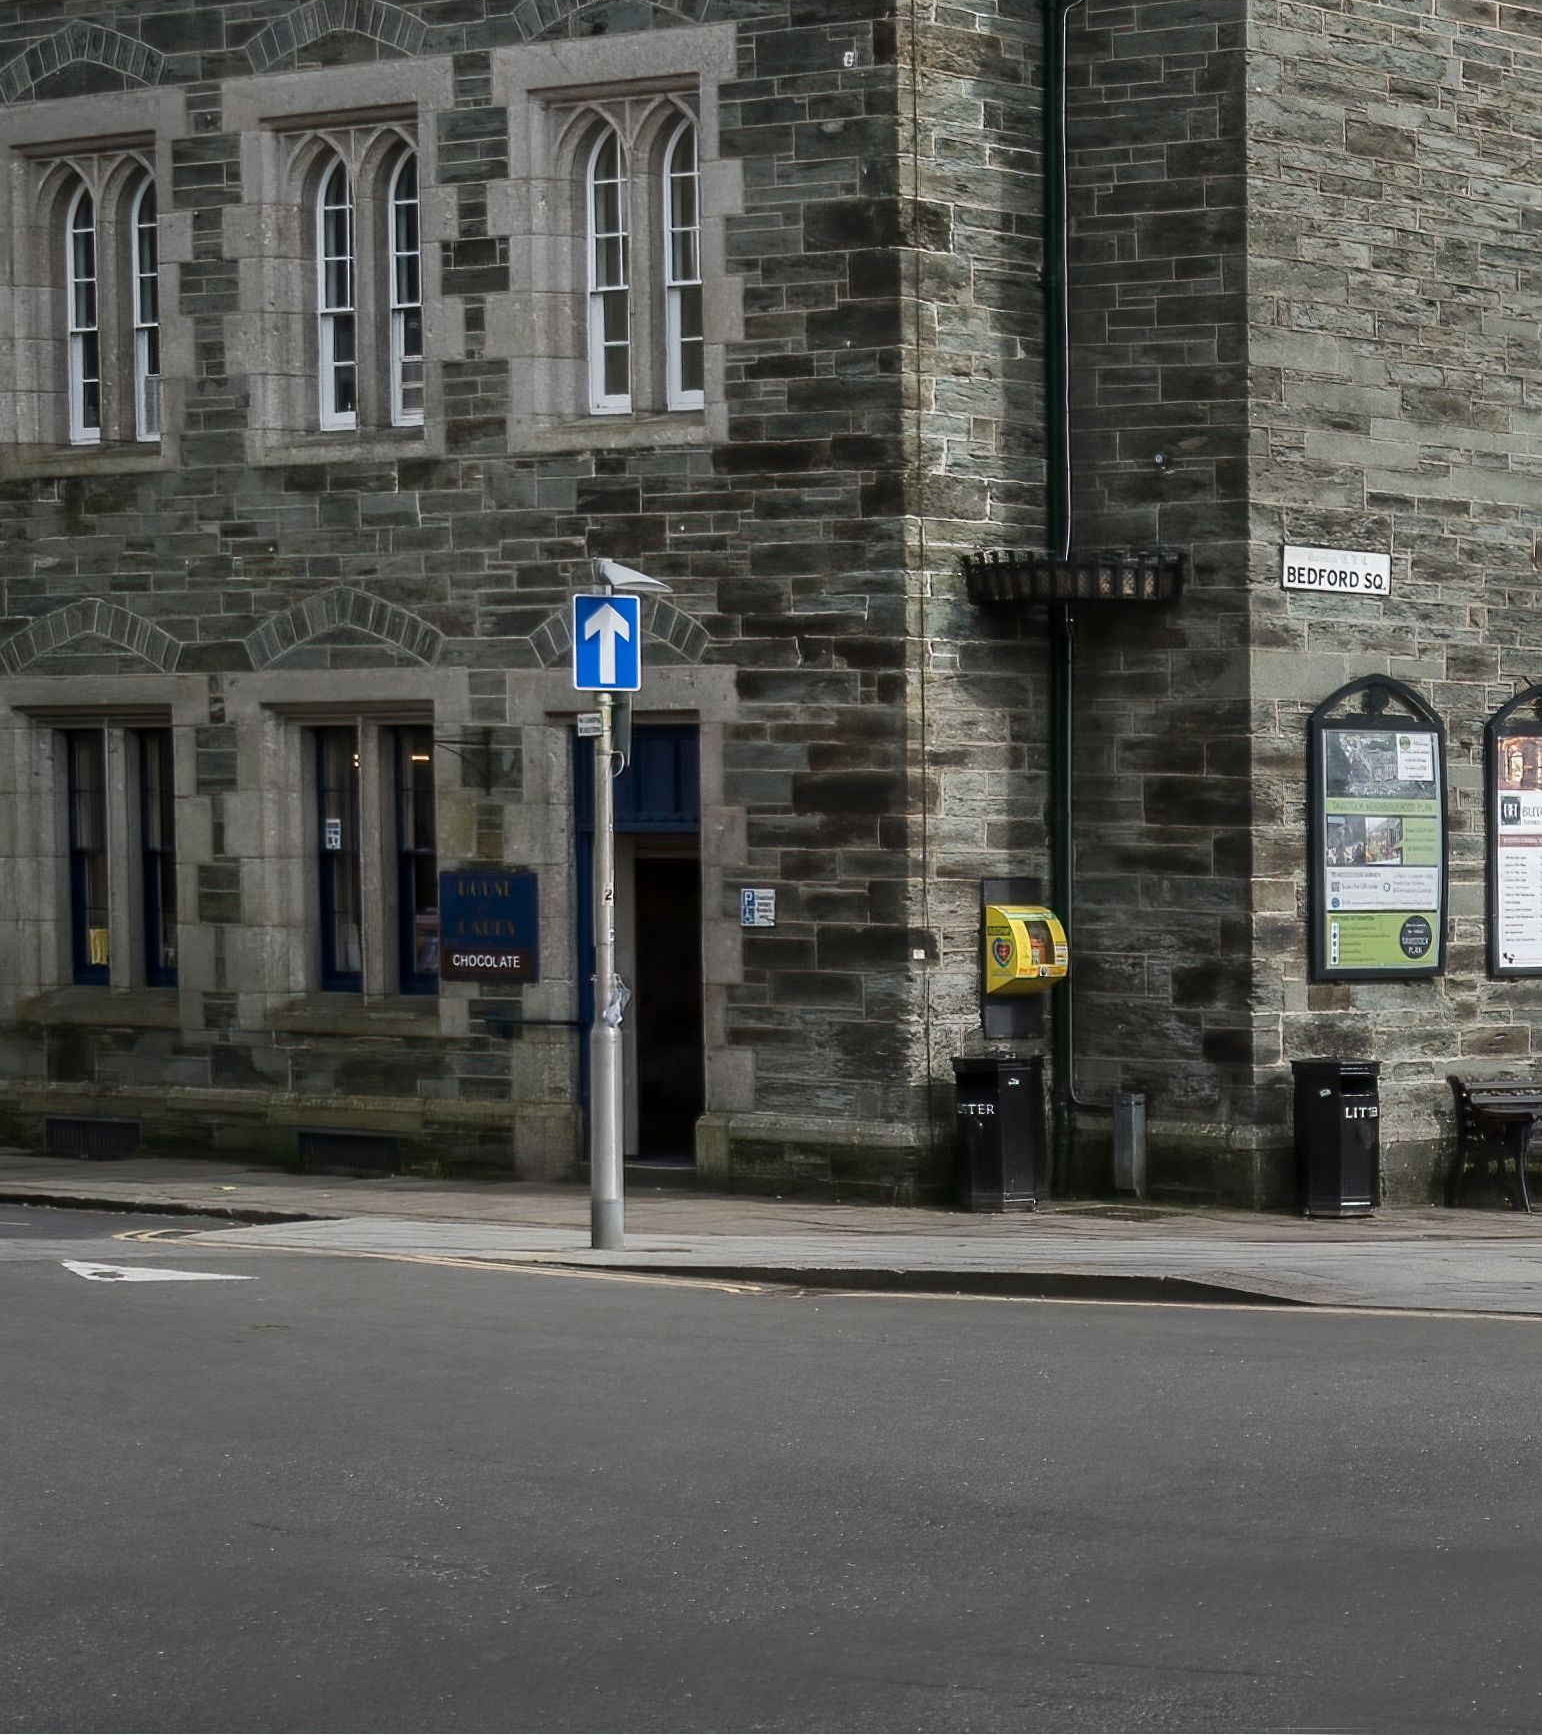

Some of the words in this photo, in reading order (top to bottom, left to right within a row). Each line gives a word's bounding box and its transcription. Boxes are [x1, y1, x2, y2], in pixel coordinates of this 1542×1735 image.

[1287, 566, 1359, 588] BEDFORD
[1364, 572, 1386, 591] SQ.
[452, 954, 521, 968] CHOCOLATE
